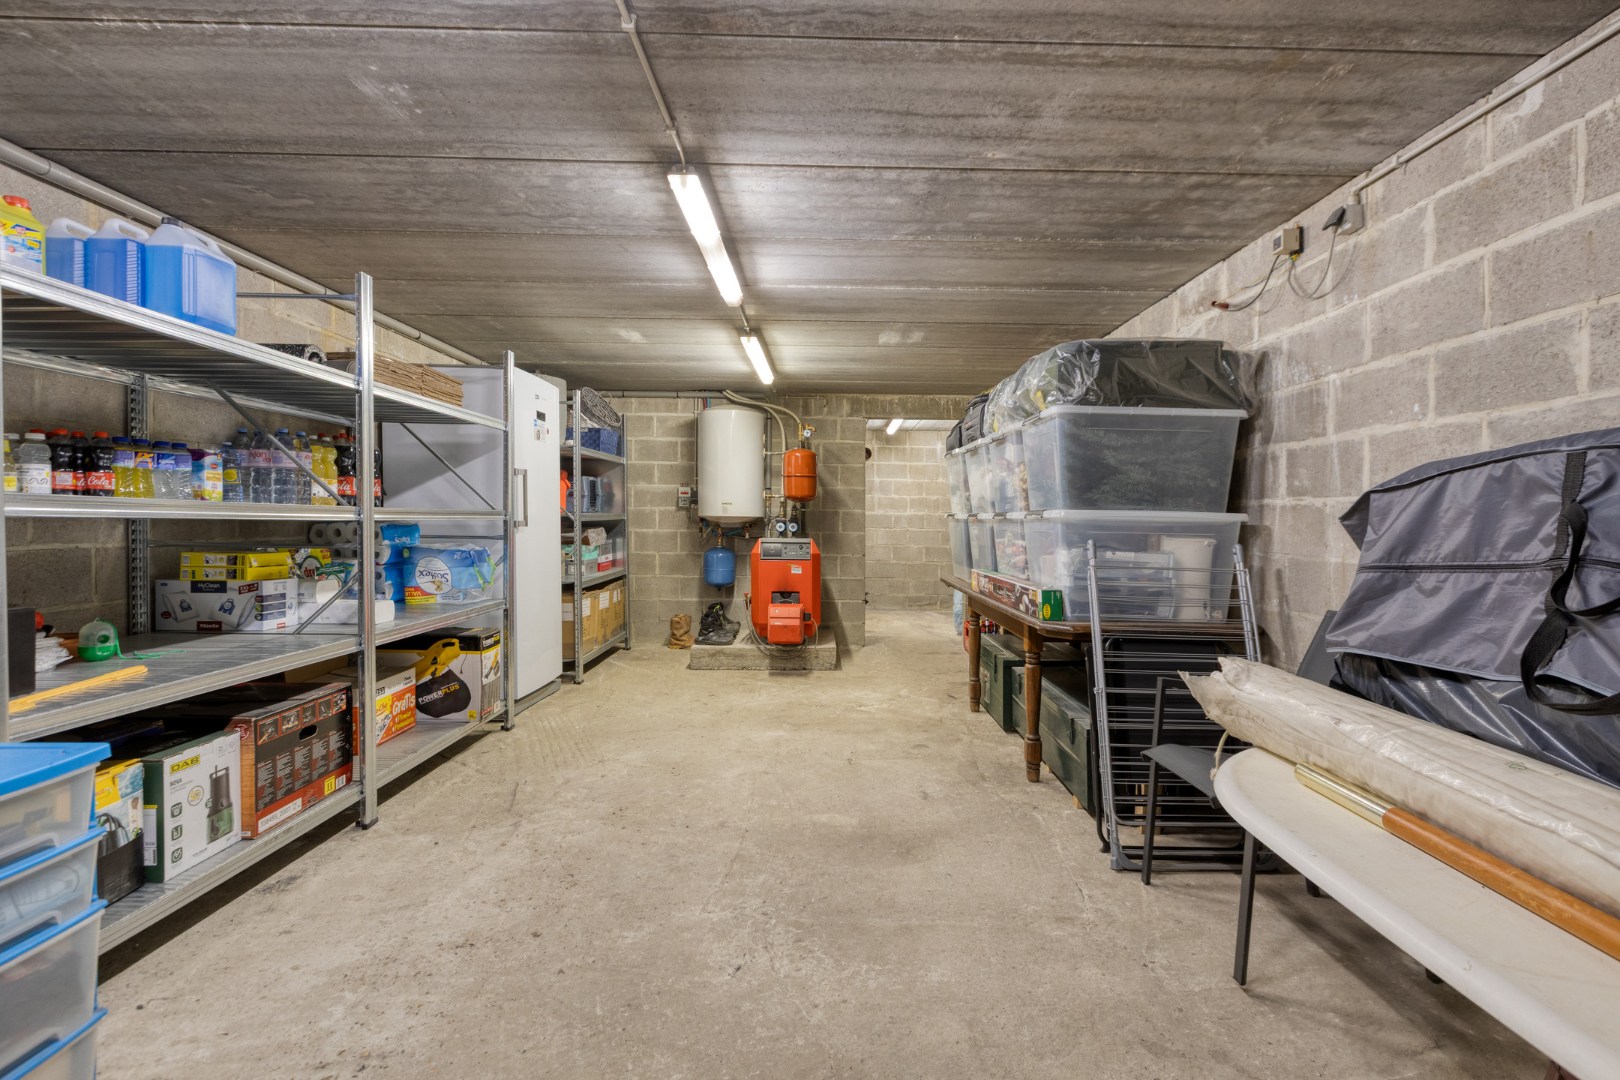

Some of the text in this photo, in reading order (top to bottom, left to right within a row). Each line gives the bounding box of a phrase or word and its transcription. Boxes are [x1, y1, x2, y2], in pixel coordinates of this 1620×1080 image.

[87, 475, 110, 486] Cola
[418, 684, 460, 704] POWERPLUS
[171, 757, 200, 773] DAB
